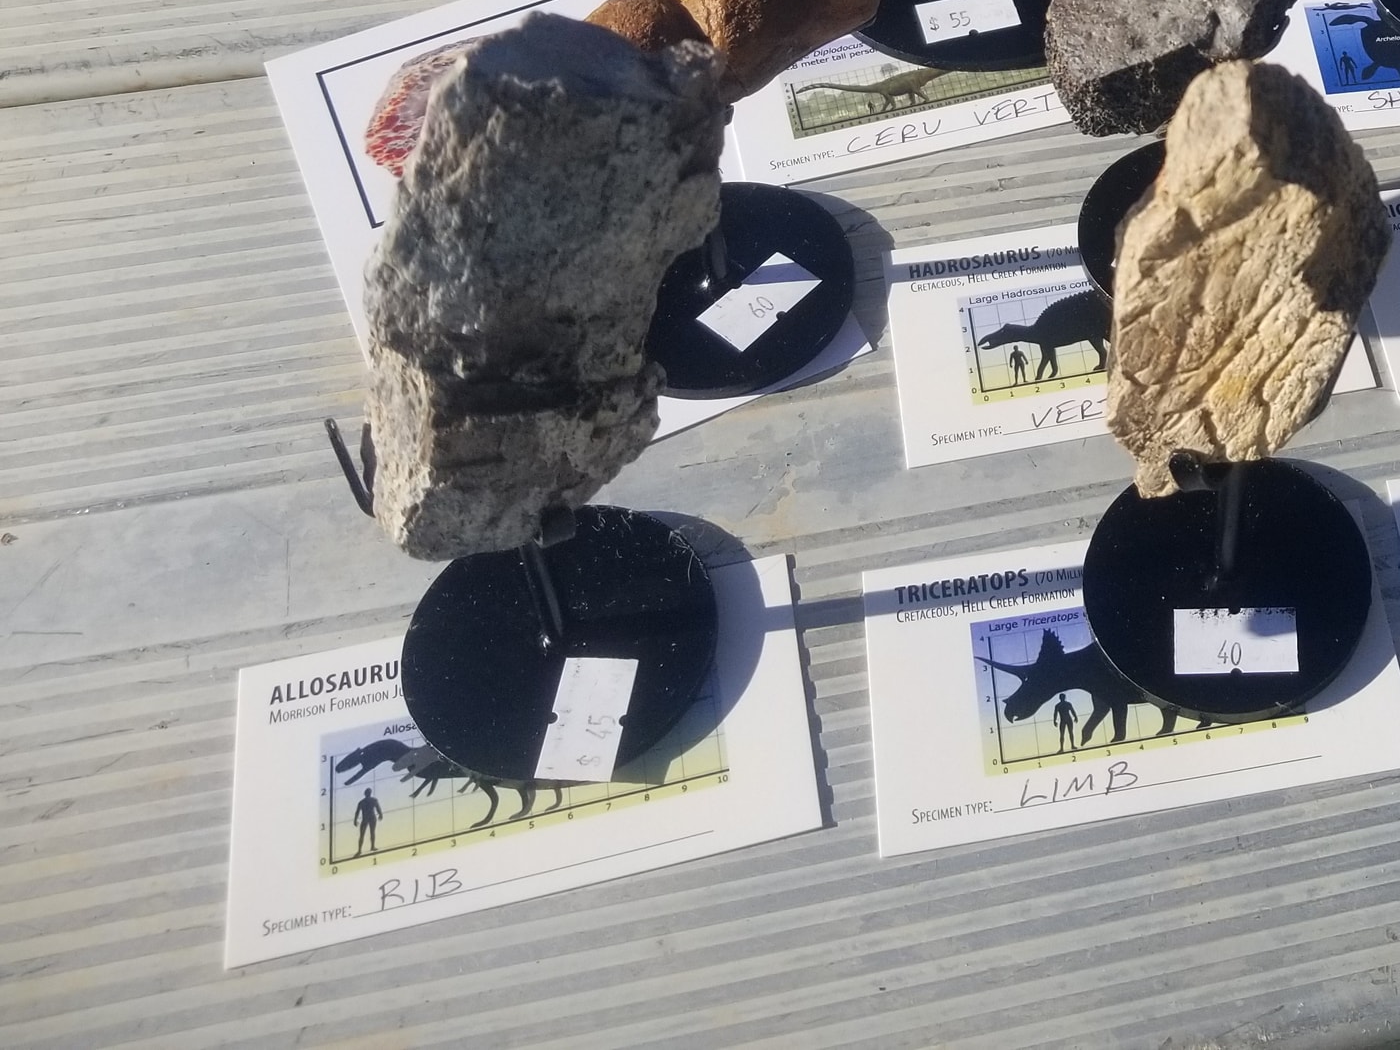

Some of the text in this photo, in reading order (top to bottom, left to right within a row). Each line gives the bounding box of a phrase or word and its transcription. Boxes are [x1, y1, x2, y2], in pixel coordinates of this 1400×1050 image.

[949, 11, 971, 28] 55
[801, 57, 829, 68] meter
[832, 53, 847, 62] tall
[849, 48, 878, 60] perso
[813, 42, 864, 58] Diplodocus
[973, 92, 1055, 125] VERT
[909, 246, 1042, 279] HADROSAURUS
[1047, 247, 1062, 259] (70
[910, 262, 1067, 293] CRETACEOUS, HELL CREEK FORMATION
[969, 293, 999, 305] Large
[1001, 284, 1067, 300] Hadrosaurus
[749, 296, 774, 319] 60
[931, 432, 975, 446] SPECIMEN
[978, 425, 1002, 438] TYPE:
[895, 567, 1083, 605] TRICERATOPS (70 MILLI
[896, 588, 1075, 623] CRETACEOUS, HELL CREEK FORMATION
[989, 611, 1080, 633] Large Triceratops
[1217, 640, 1242, 666] 40
[270, 660, 398, 705] ALLOSAURU
[269, 703, 326, 725] MORRISON
[330, 690, 389, 712] FORMATION
[383, 722, 417, 737] Allosa
[585, 715, 616, 740] 45
[322, 754, 328, 763] 3
[320, 788, 327, 796] 2
[911, 761, 1137, 824] SPECIMEN TYPE: LIMB
[320, 823, 326, 831] 1
[332, 774, 728, 875] 0 1 2 3 4 5 6 7 8 9 10
[320, 858, 326, 866] 0
[262, 869, 463, 936] SPECIMEN TYPE: RIB
